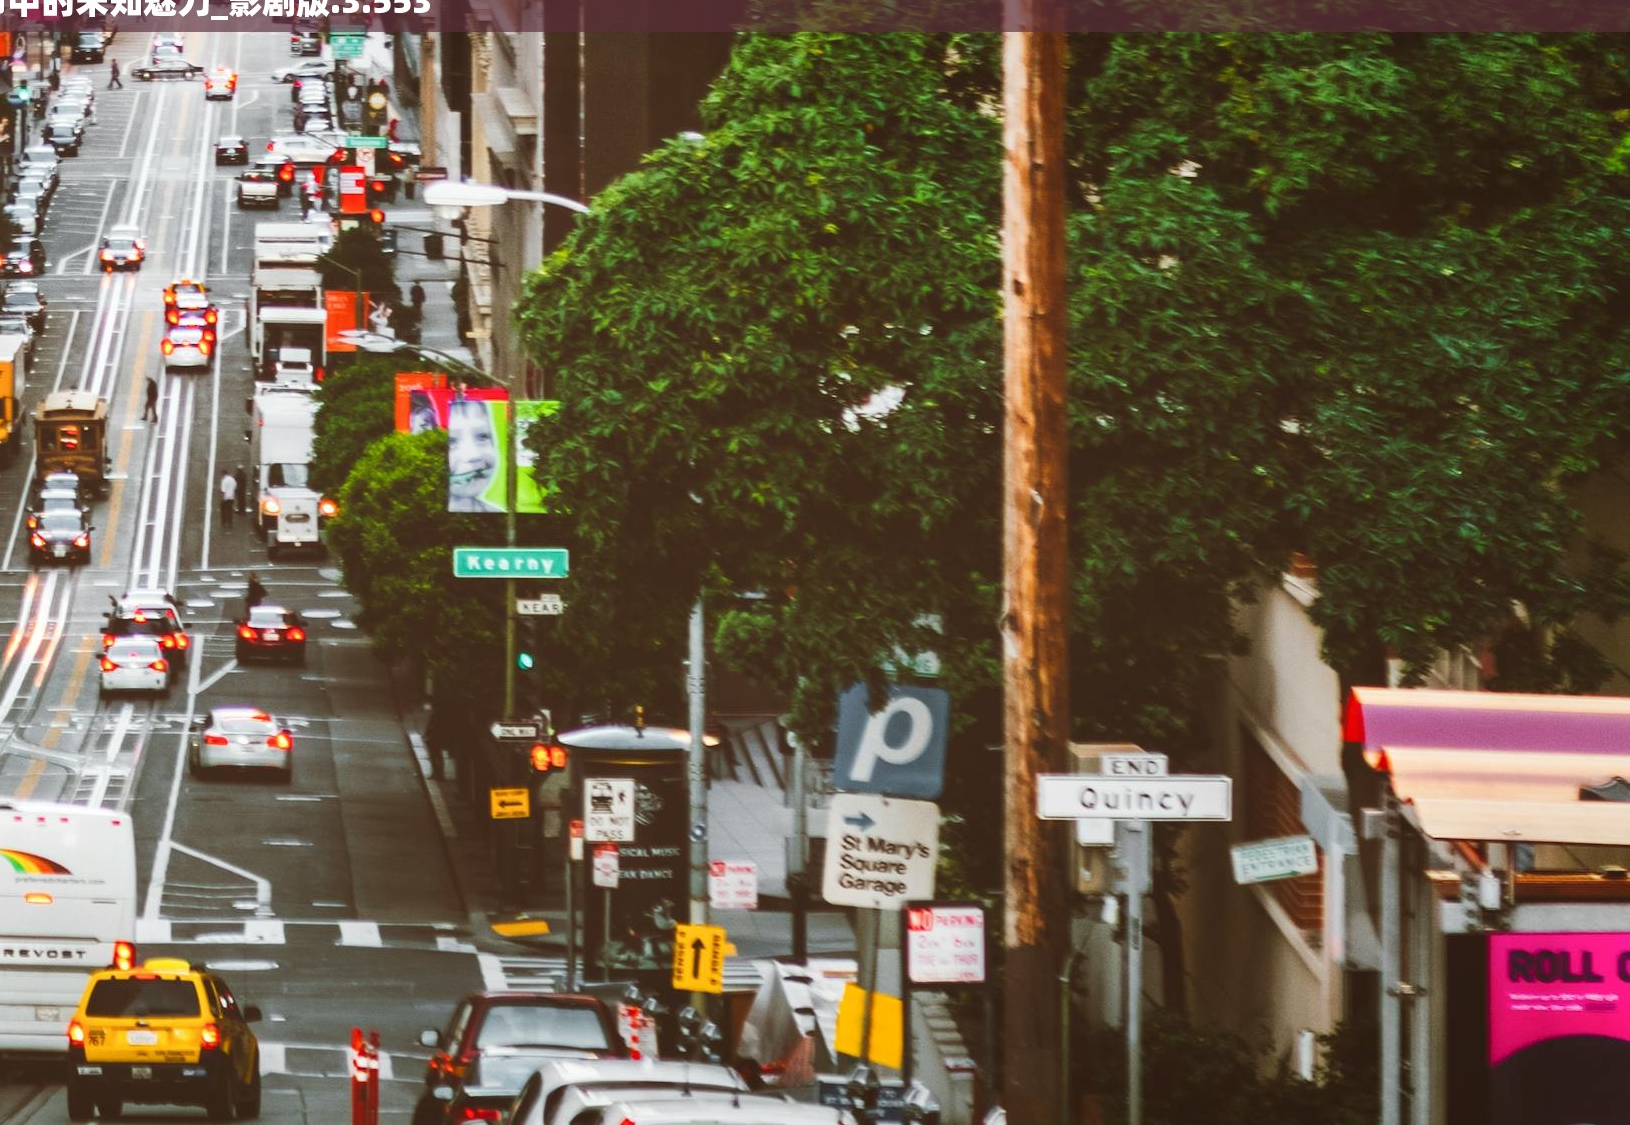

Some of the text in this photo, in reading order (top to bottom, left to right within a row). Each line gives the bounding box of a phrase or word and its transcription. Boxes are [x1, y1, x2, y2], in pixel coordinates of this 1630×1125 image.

[466, 555, 554, 575] Kearny
[521, 603, 561, 613] KEAR
[1112, 760, 1159, 775] END
[1079, 786, 1195, 816] Quincy
[590, 817, 630, 826] DO NOT
[596, 829, 624, 839] PASS
[620, 848, 649, 857] SICAL
[841, 835, 930, 860] St Mary's
[840, 853, 907, 875] Square
[839, 873, 907, 897] Garage
[1508, 949, 1604, 983] ROLL
